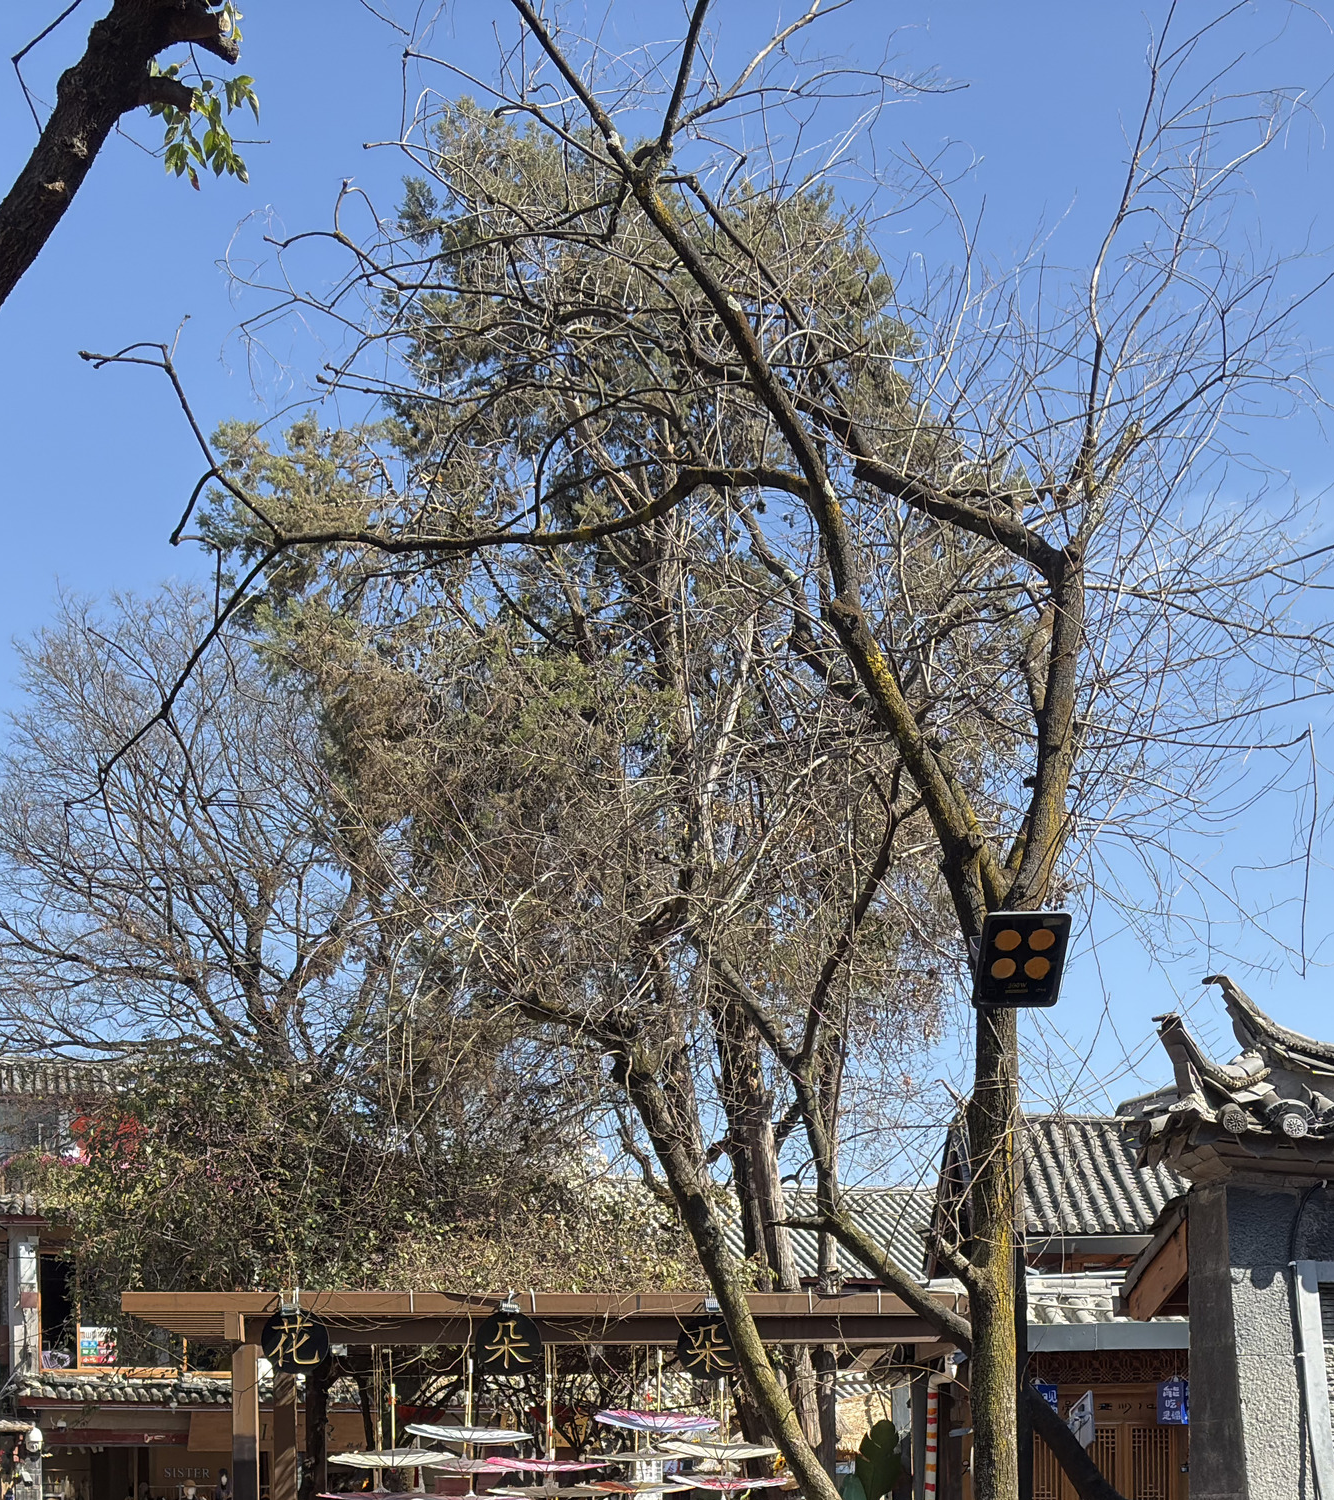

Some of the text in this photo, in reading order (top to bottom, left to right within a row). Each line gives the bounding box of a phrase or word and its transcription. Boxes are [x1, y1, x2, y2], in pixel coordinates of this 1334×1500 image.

[268, 1316, 735, 1373] 花 朵 朵
[163, 1467, 211, 1479] SISTER
